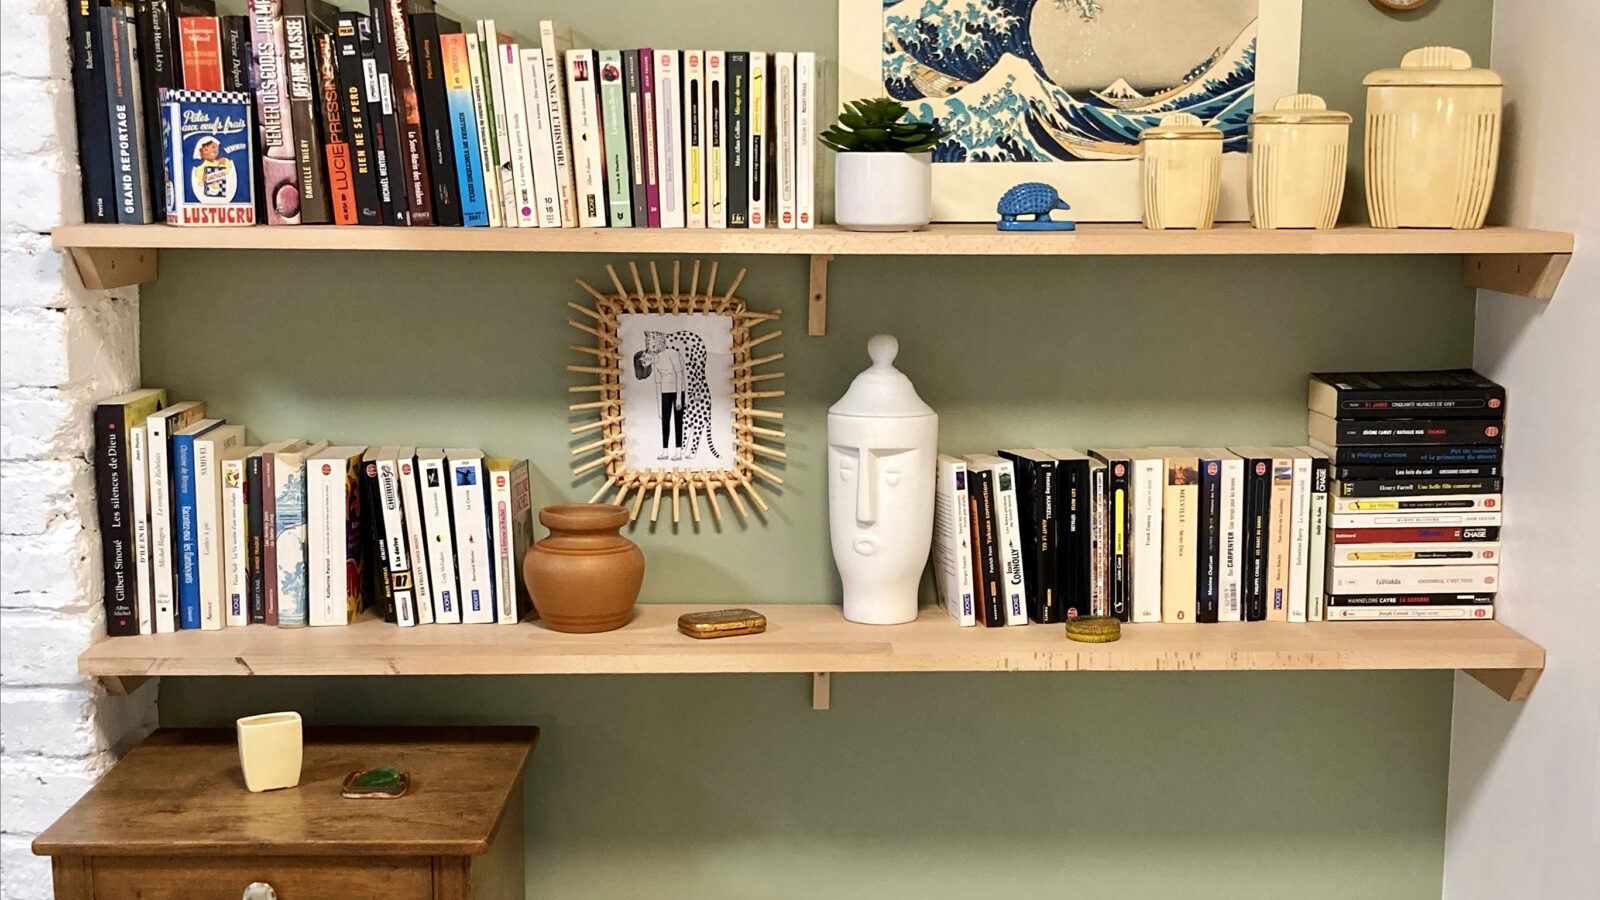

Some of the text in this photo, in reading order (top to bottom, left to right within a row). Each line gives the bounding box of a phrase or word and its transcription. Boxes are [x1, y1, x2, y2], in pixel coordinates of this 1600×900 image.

[258, 42, 283, 146] L'ENFER DES CODES
[290, 62, 310, 97] AFFAIRE
[183, 109, 209, 124] Pâtes
[223, 116, 246, 133] frais
[546, 57, 566, 169] LE SANG ET L'HISTOIRE
[348, 86, 368, 173] RIEN NE SE PERD
[116, 105, 135, 213] GRAND REPORTAGE
[332, 144, 348, 190] LUCIE
[408, 139, 420, 170] Sous-Marin
[303, 167, 314, 199] DANIELLE
[377, 150, 391, 202] MICHAËL MENTION
[412, 171, 420, 180] des
[183, 207, 253, 224] LUSTUCRU
[180, 445, 188, 467] Christine
[199, 445, 208, 476] SAMIVEL
[107, 434, 121, 527] Les silences de Dieu
[155, 478, 162, 486] de
[386, 477, 395, 510] CHERUB
[157, 508, 163, 516] Le
[982, 481, 990, 519] connection
[138, 531, 145, 542] EN
[181, 506, 194, 584] Racontez-moi les flamboyants
[138, 544, 146, 563] D'ILE
[1010, 548, 1021, 585] CONNOLLY
[113, 539, 126, 601] Gilbert Sinoué
[395, 574, 408, 588] 07
[472, 589, 480, 611] POCKET
